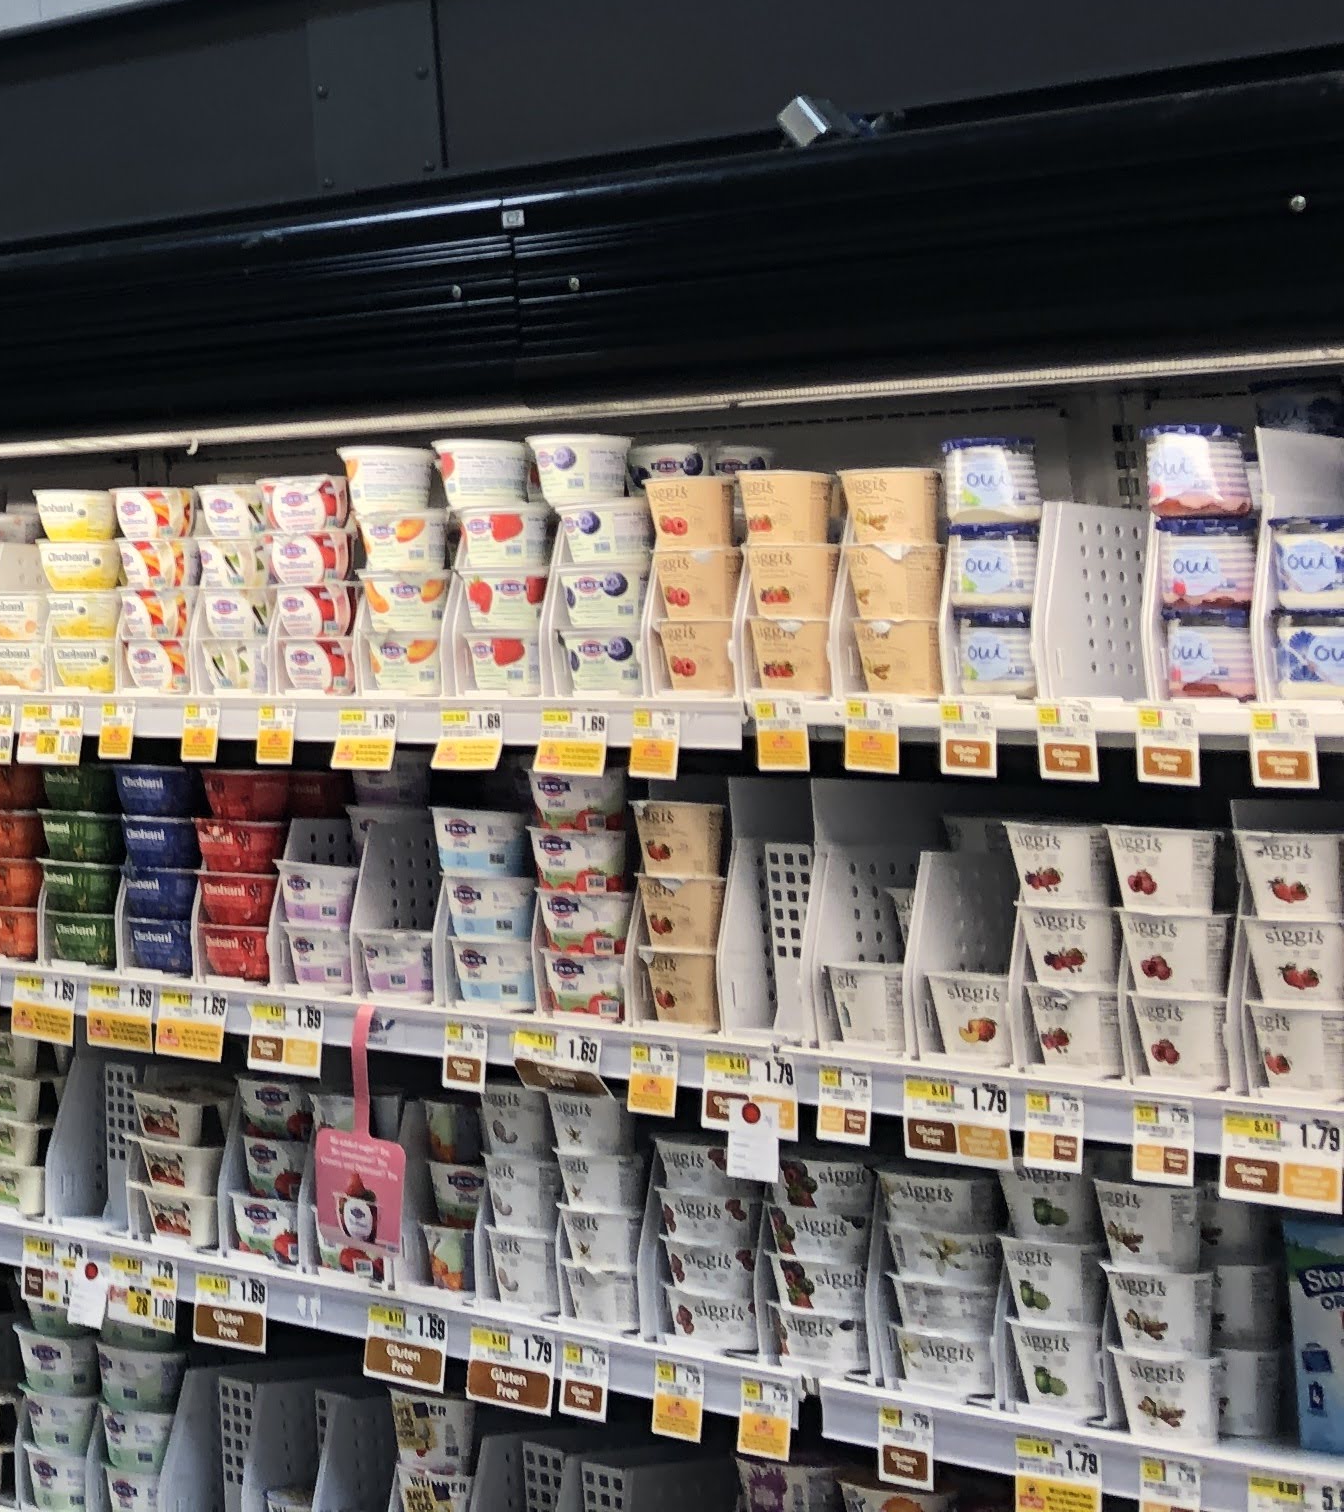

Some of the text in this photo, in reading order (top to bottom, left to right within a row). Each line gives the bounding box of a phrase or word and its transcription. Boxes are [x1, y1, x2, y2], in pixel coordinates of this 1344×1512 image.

[965, 557, 1002, 574] oui
[1174, 559, 1211, 575] oui
[1288, 554, 1332, 572] oui
[968, 645, 1008, 661] oui
[1173, 643, 1209, 661] oui
[374, 713, 395, 729] 1.69
[478, 713, 501, 730] 1.69
[580, 715, 605, 732] 1.69
[54, 980, 74, 1001] 1.69
[130, 992, 152, 1009] 1.69
[202, 997, 226, 1015] 1.69
[297, 1009, 321, 1028] 1.69
[568, 1040, 596, 1063] 1.69
[765, 1060, 794, 1085] 1.79
[971, 1087, 1006, 1113] 1.79
[1300, 1123, 1341, 1152] 1.79
[241, 1282, 266, 1304] 1.69
[213, 1310, 244, 1326] Gluten
[218, 1325, 238, 1339] Free
[417, 1315, 445, 1340] 1.69
[387, 1344, 421, 1363] Gluten
[524, 1338, 552, 1364] 1.79
[391, 1359, 413, 1376] Free
[491, 1369, 527, 1387] Gluten
[496, 1384, 520, 1401] Free
[1066, 1449, 1098, 1475] 1.79
